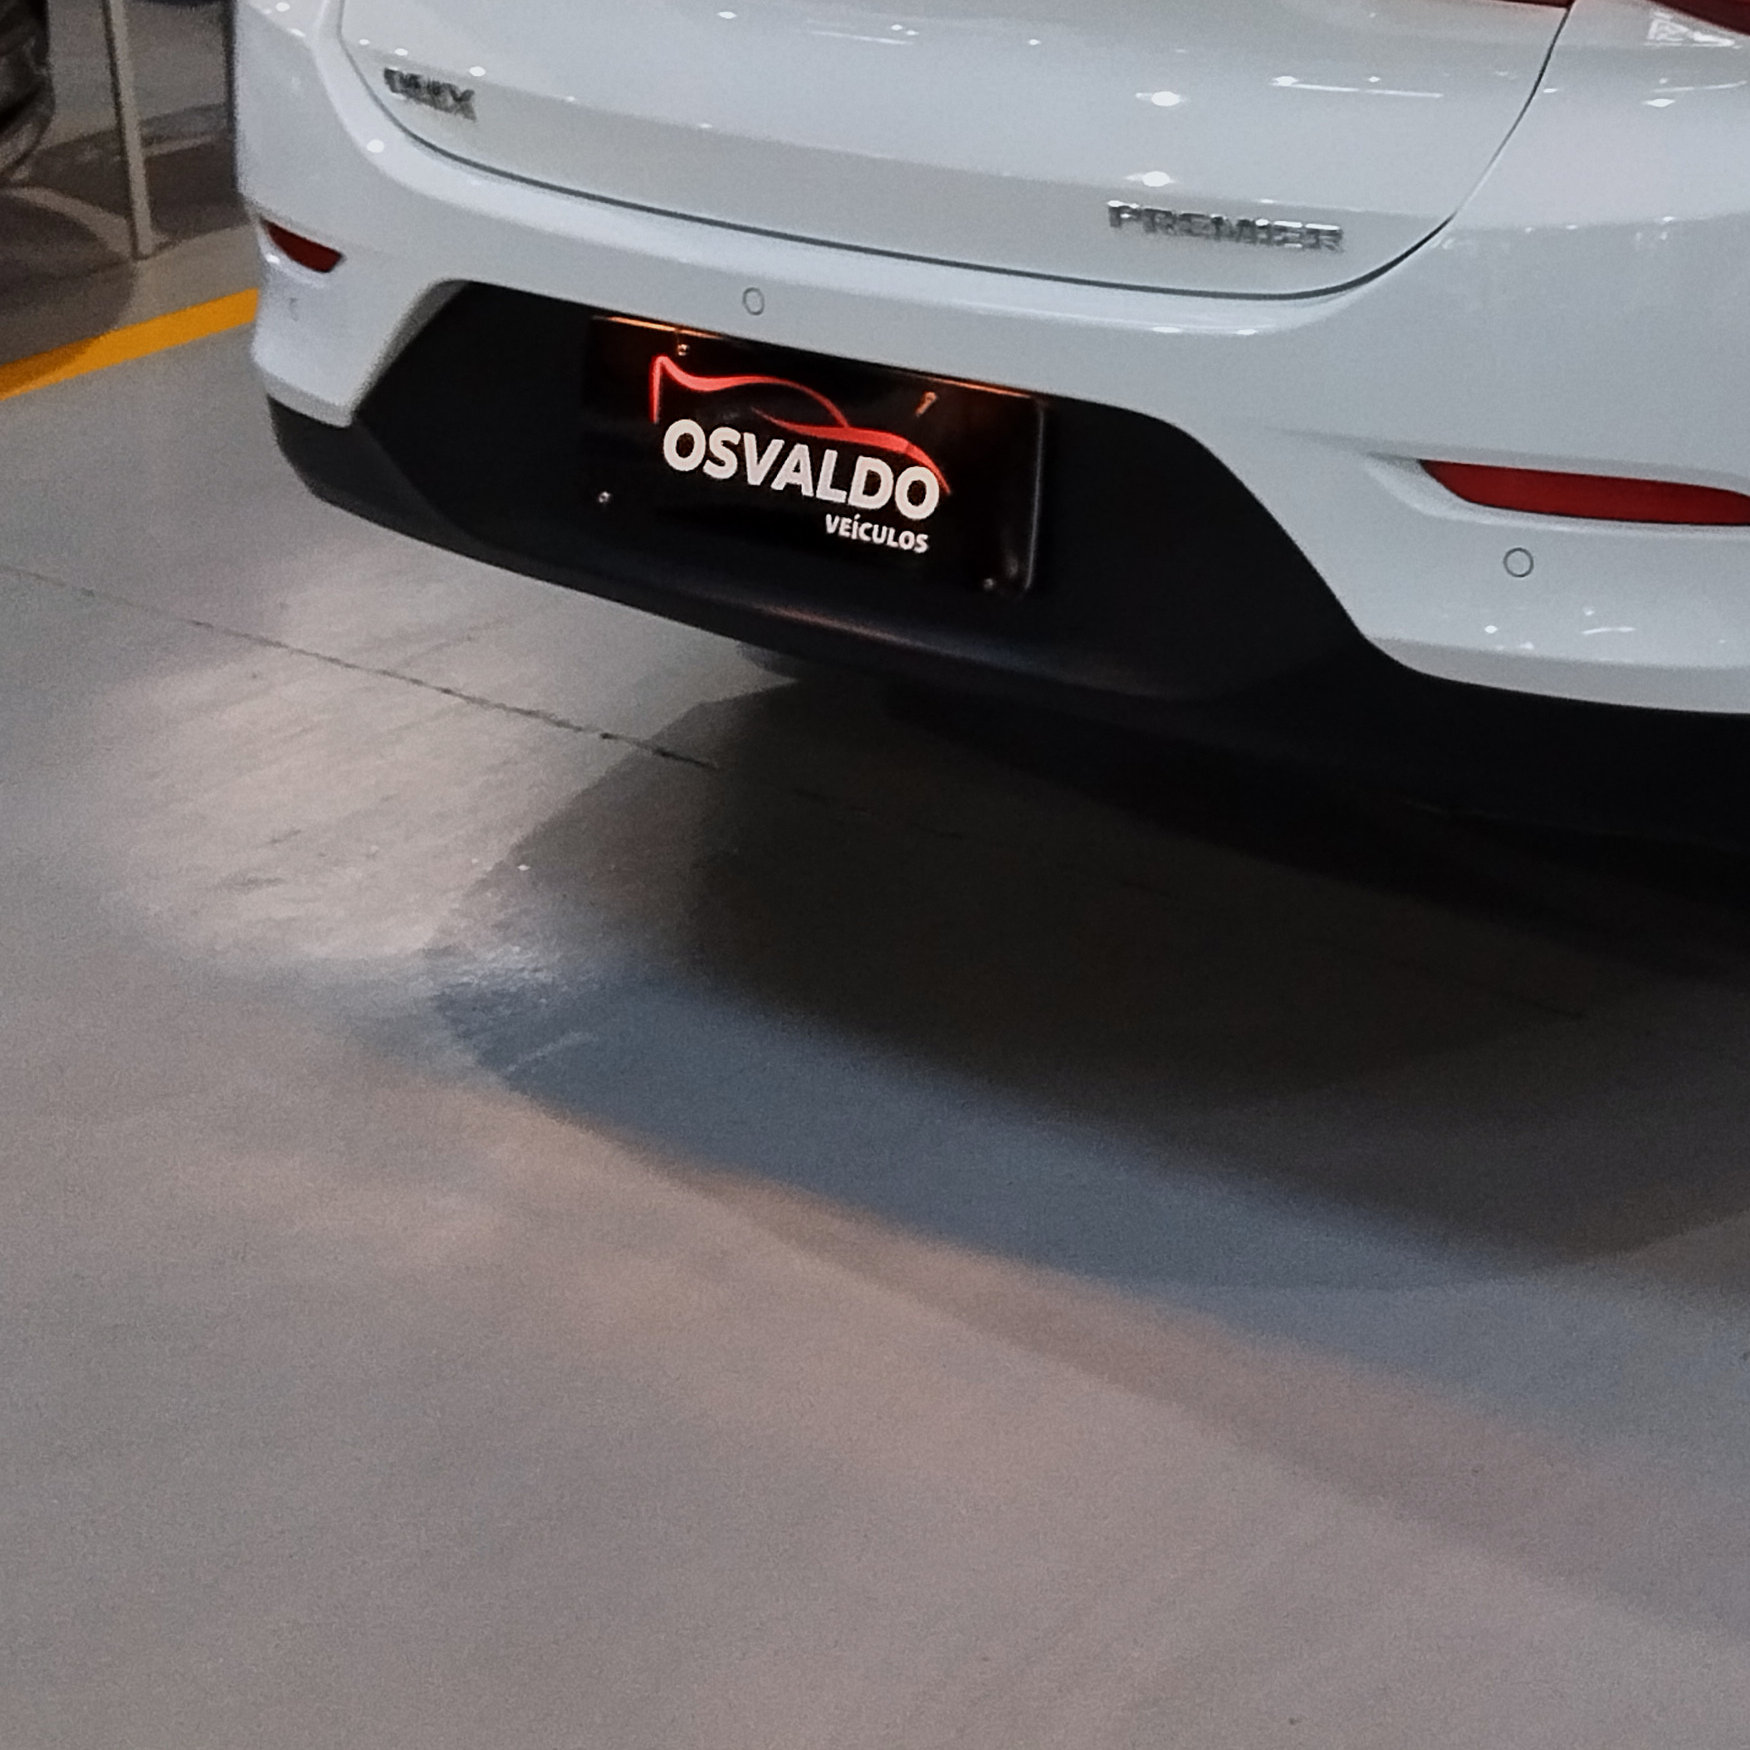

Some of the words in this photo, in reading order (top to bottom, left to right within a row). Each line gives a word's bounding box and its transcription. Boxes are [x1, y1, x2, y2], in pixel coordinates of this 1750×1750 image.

[1107, 199, 1345, 254] PREMIER
[662, 418, 941, 521] OSVALDO
[825, 513, 930, 554] VEÍCULOS
